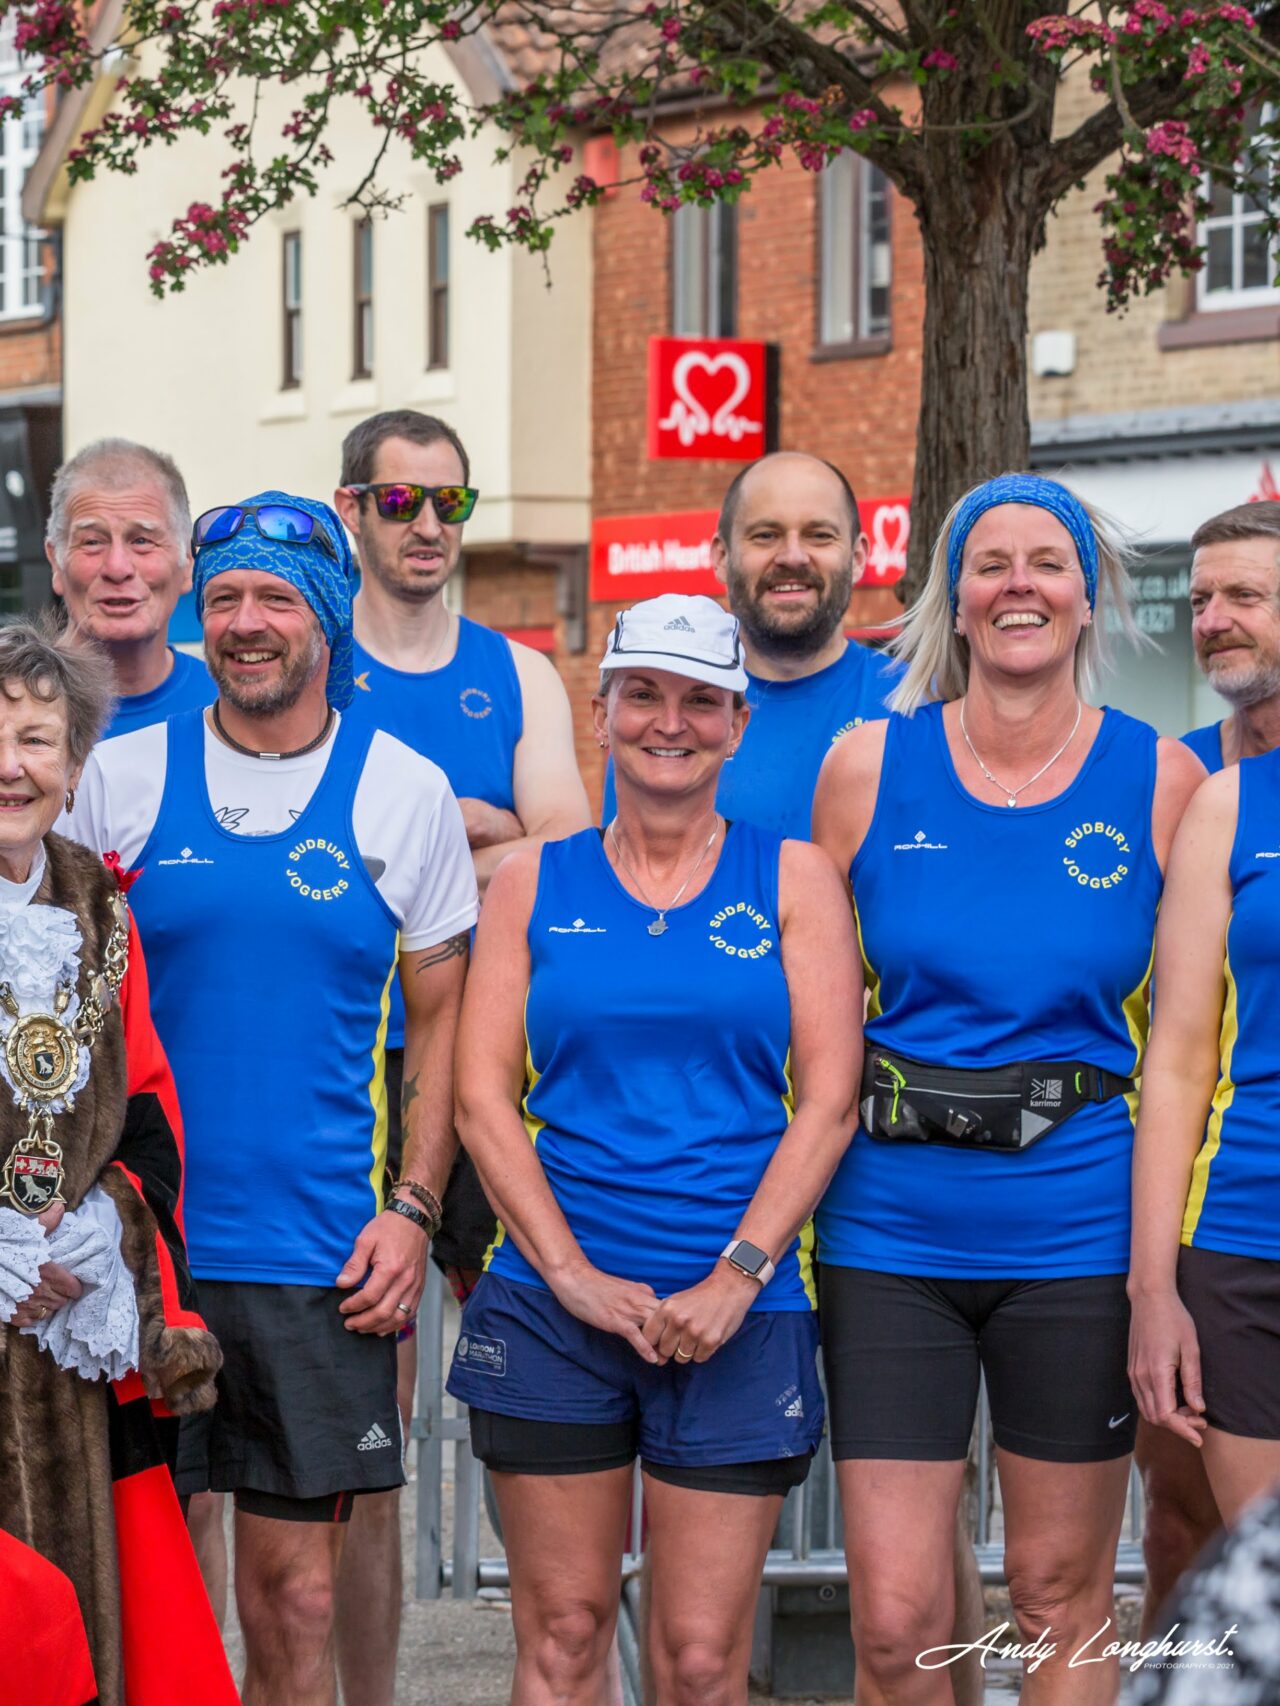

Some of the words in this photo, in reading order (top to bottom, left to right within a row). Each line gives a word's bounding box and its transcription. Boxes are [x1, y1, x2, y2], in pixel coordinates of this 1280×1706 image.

[663, 624, 696, 633] adidas
[893, 843, 948, 851] RONHILL
[1064, 821, 1130, 854] SUDBURY
[158, 855, 214, 866] RONHILL
[288, 838, 350, 872] SUDBURY
[286, 868, 349, 901] JOGGERS
[1063, 857, 1129, 889] JOGGERS
[709, 901, 771, 931] SUDBURY
[708, 934, 773, 959] JOGGERS
[357, 1437, 392, 1451] adidas
